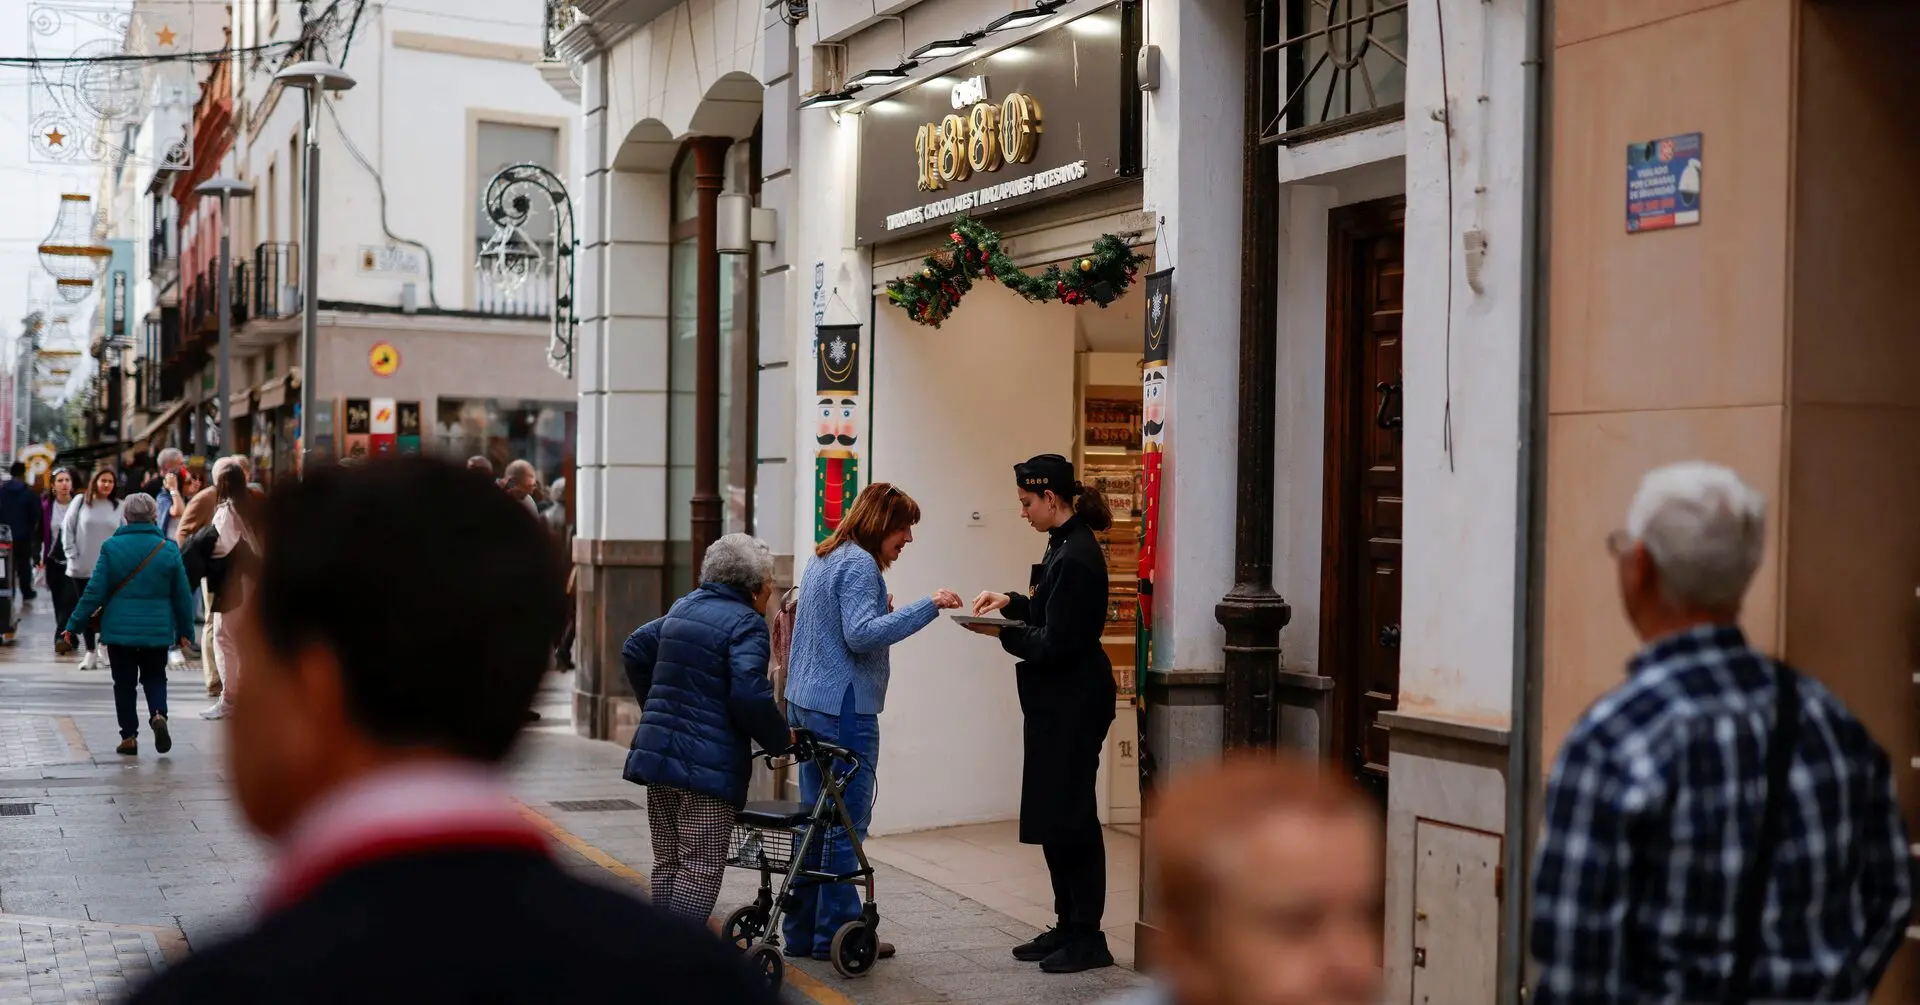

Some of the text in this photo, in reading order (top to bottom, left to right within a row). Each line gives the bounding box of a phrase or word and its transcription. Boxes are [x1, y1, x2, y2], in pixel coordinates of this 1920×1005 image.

[915, 93, 1044, 192] 1880
[924, 192, 974, 220] CHOCOLATES
[972, 190, 980, 207] Y
[979, 175, 1034, 206] MAZAPANES
[1032, 160, 1088, 191] ARTESANOS
[1025, 477, 1049, 485] 1880
